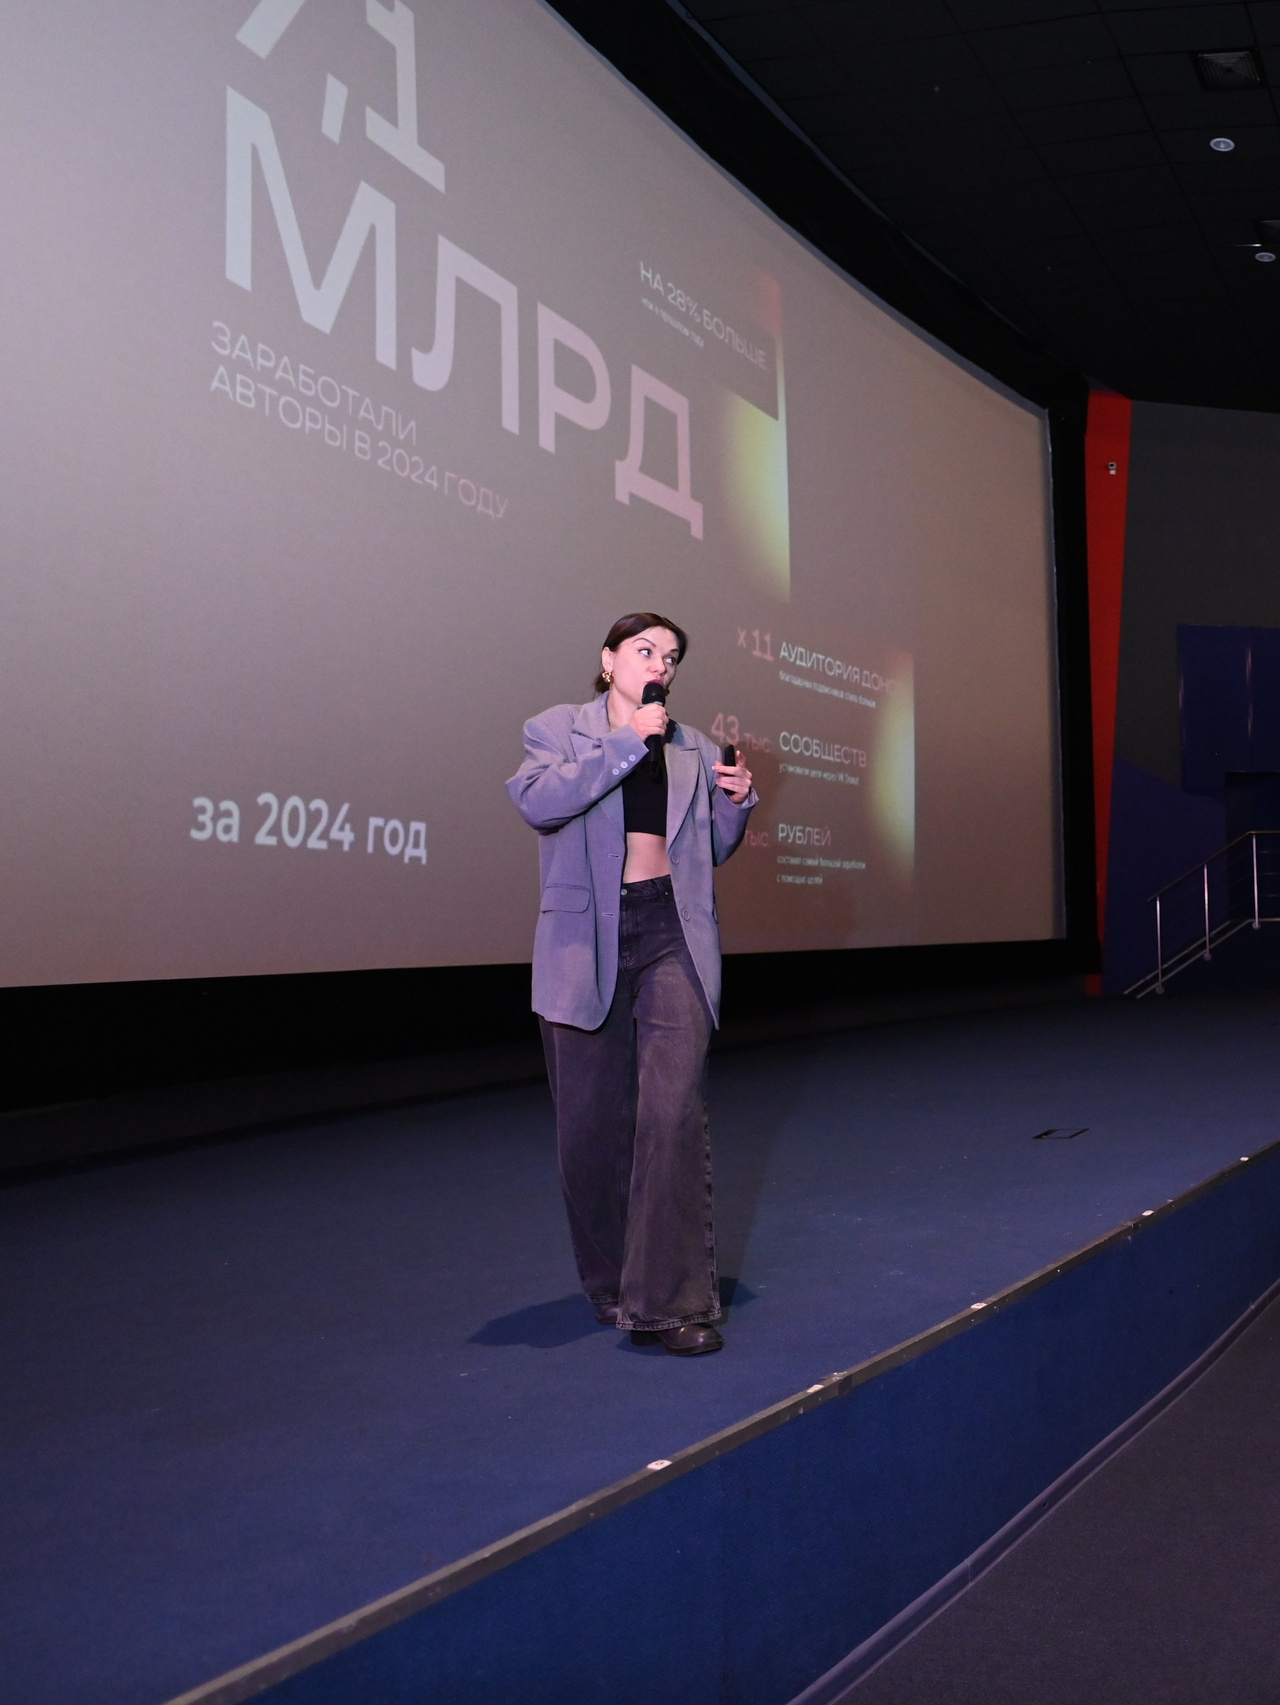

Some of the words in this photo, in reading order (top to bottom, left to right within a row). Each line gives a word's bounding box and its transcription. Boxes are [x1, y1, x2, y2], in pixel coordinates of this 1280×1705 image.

[225, 84, 704, 541] МЛРД
[640, 260, 665, 297] НА
[667, 282, 702, 323] 28%
[702, 308, 768, 371] БОЛЬШЕ
[211, 320, 417, 446] ЗАРАБОТАЛИ
[210, 365, 347, 451] АВТОРЫ
[354, 429, 372, 461] В
[377, 440, 438, 491] 2024
[443, 470, 509, 520] ГОДУ
[751, 628, 774, 662] 11
[779, 641, 862, 685] АУДИТОРИЯ
[861, 669, 903, 696] ДОНО
[711, 712, 740, 747] 43
[779, 731, 868, 769] СООБЩЕСТВ
[190, 796, 241, 843] за
[254, 792, 355, 852] 2024
[367, 816, 428, 865] год
[778, 822, 832, 846] РУБЛЕЙ
